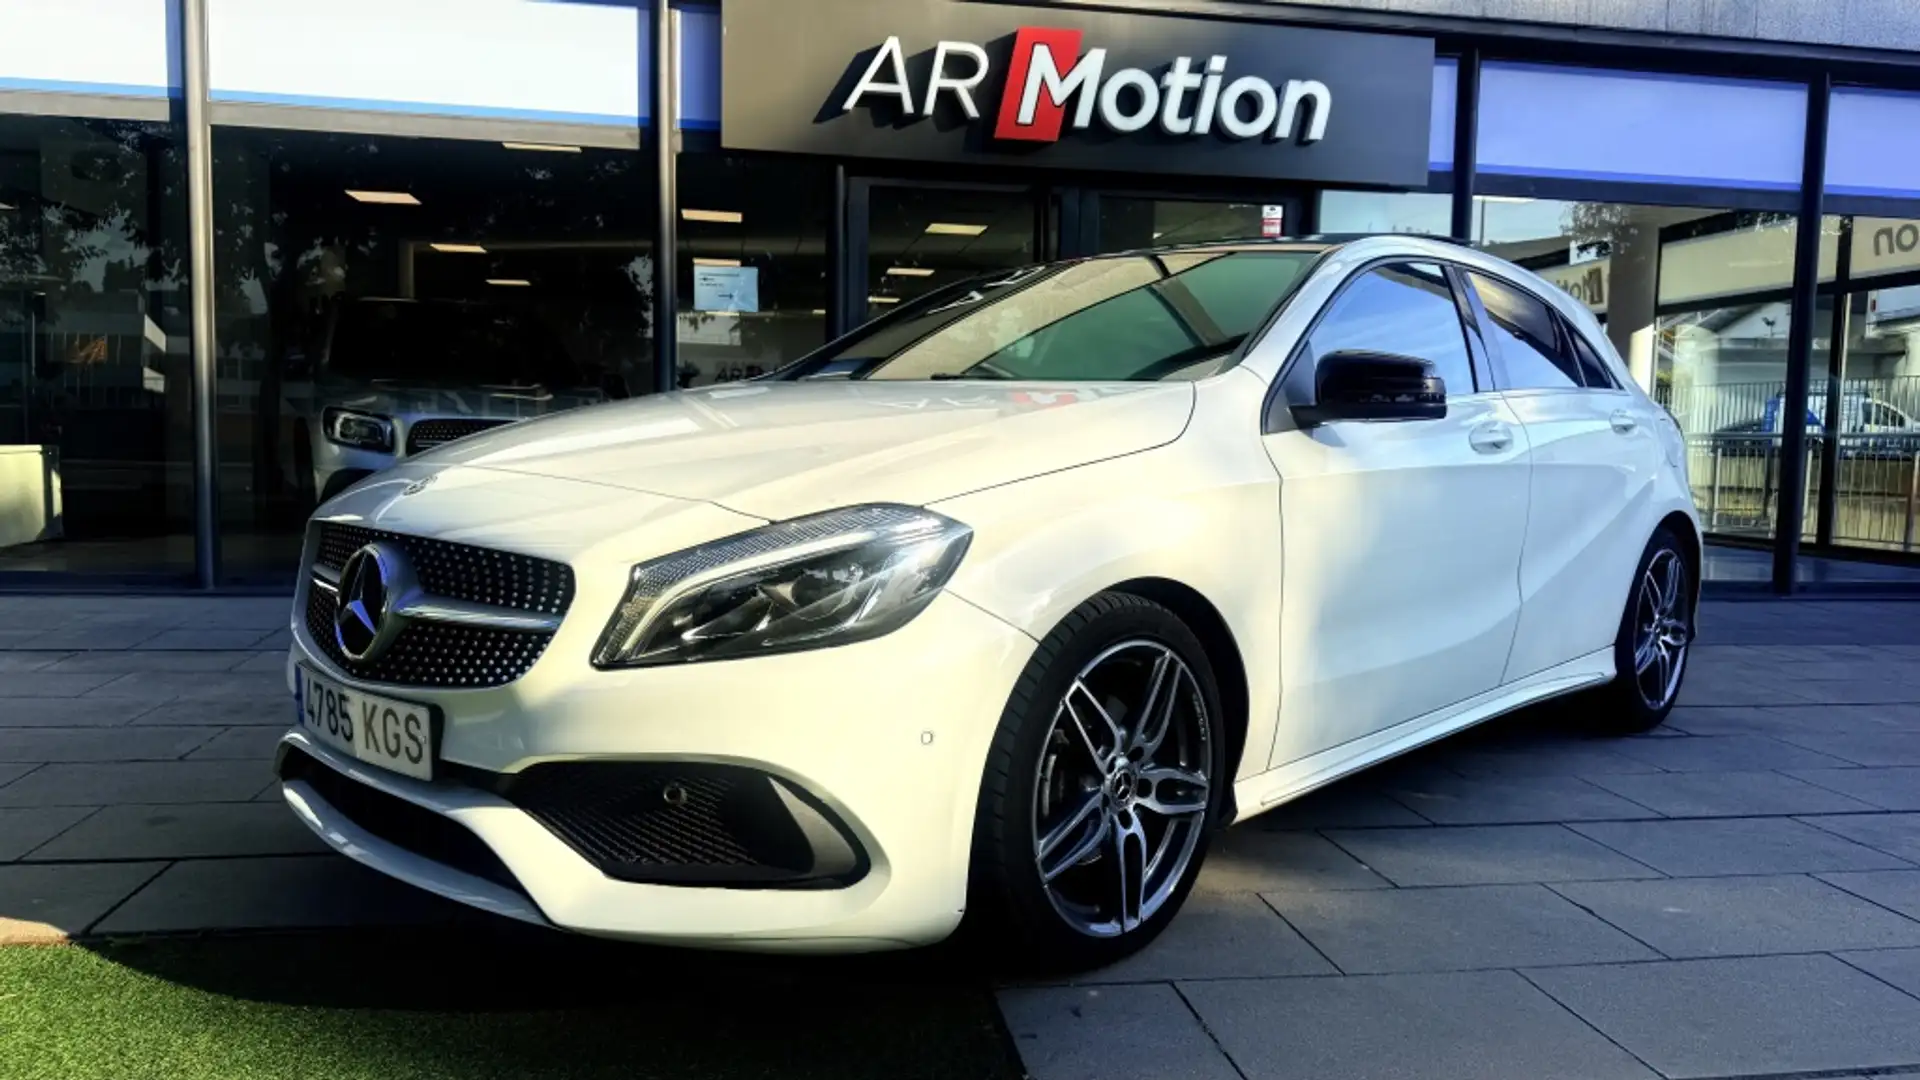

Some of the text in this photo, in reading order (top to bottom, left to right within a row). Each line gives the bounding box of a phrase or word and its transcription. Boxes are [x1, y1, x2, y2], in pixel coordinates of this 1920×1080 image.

[842, 36, 1332, 142] AR Motion
[306, 678, 423, 764] 4785 KGS
